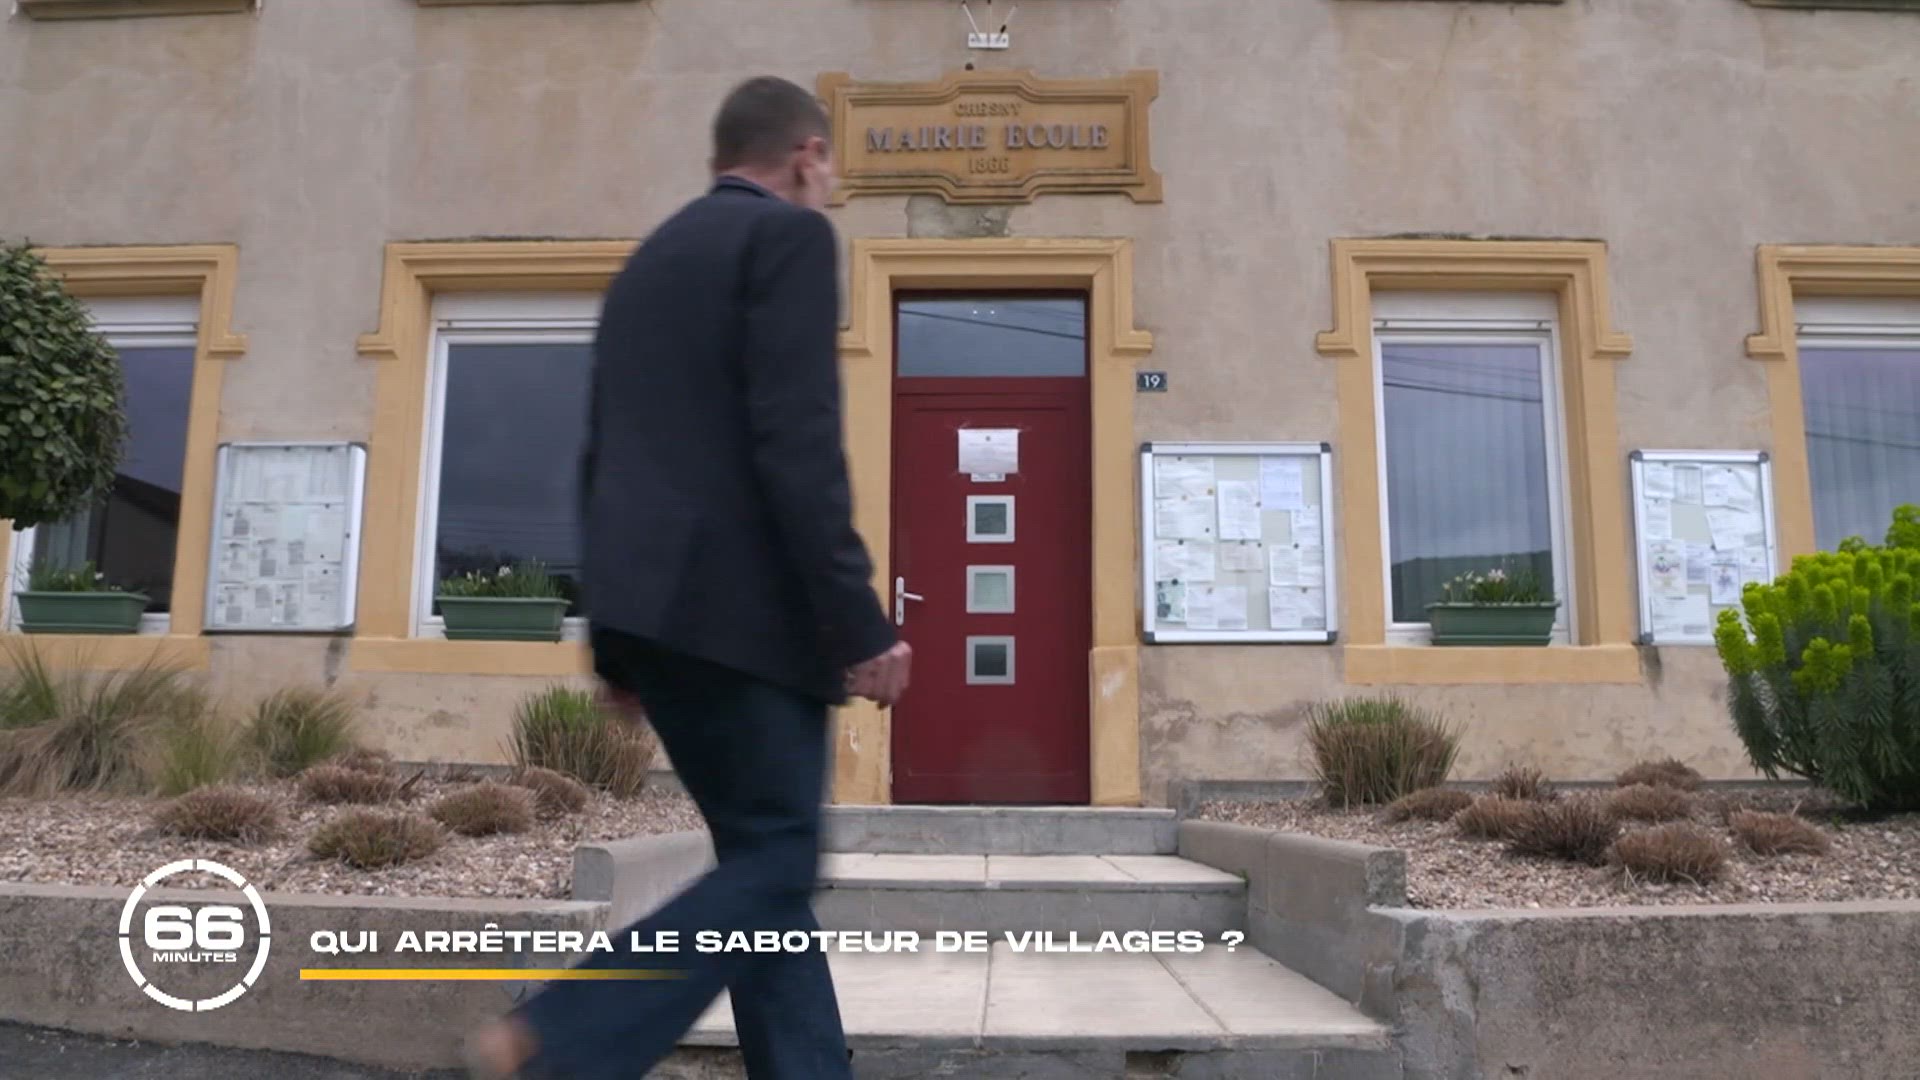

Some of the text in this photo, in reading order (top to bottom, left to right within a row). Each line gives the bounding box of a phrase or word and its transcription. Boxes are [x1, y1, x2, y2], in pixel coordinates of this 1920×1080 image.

[866, 124, 1108, 151] MAIRIE ECOLE
[1143, 374, 1160, 388] 19
